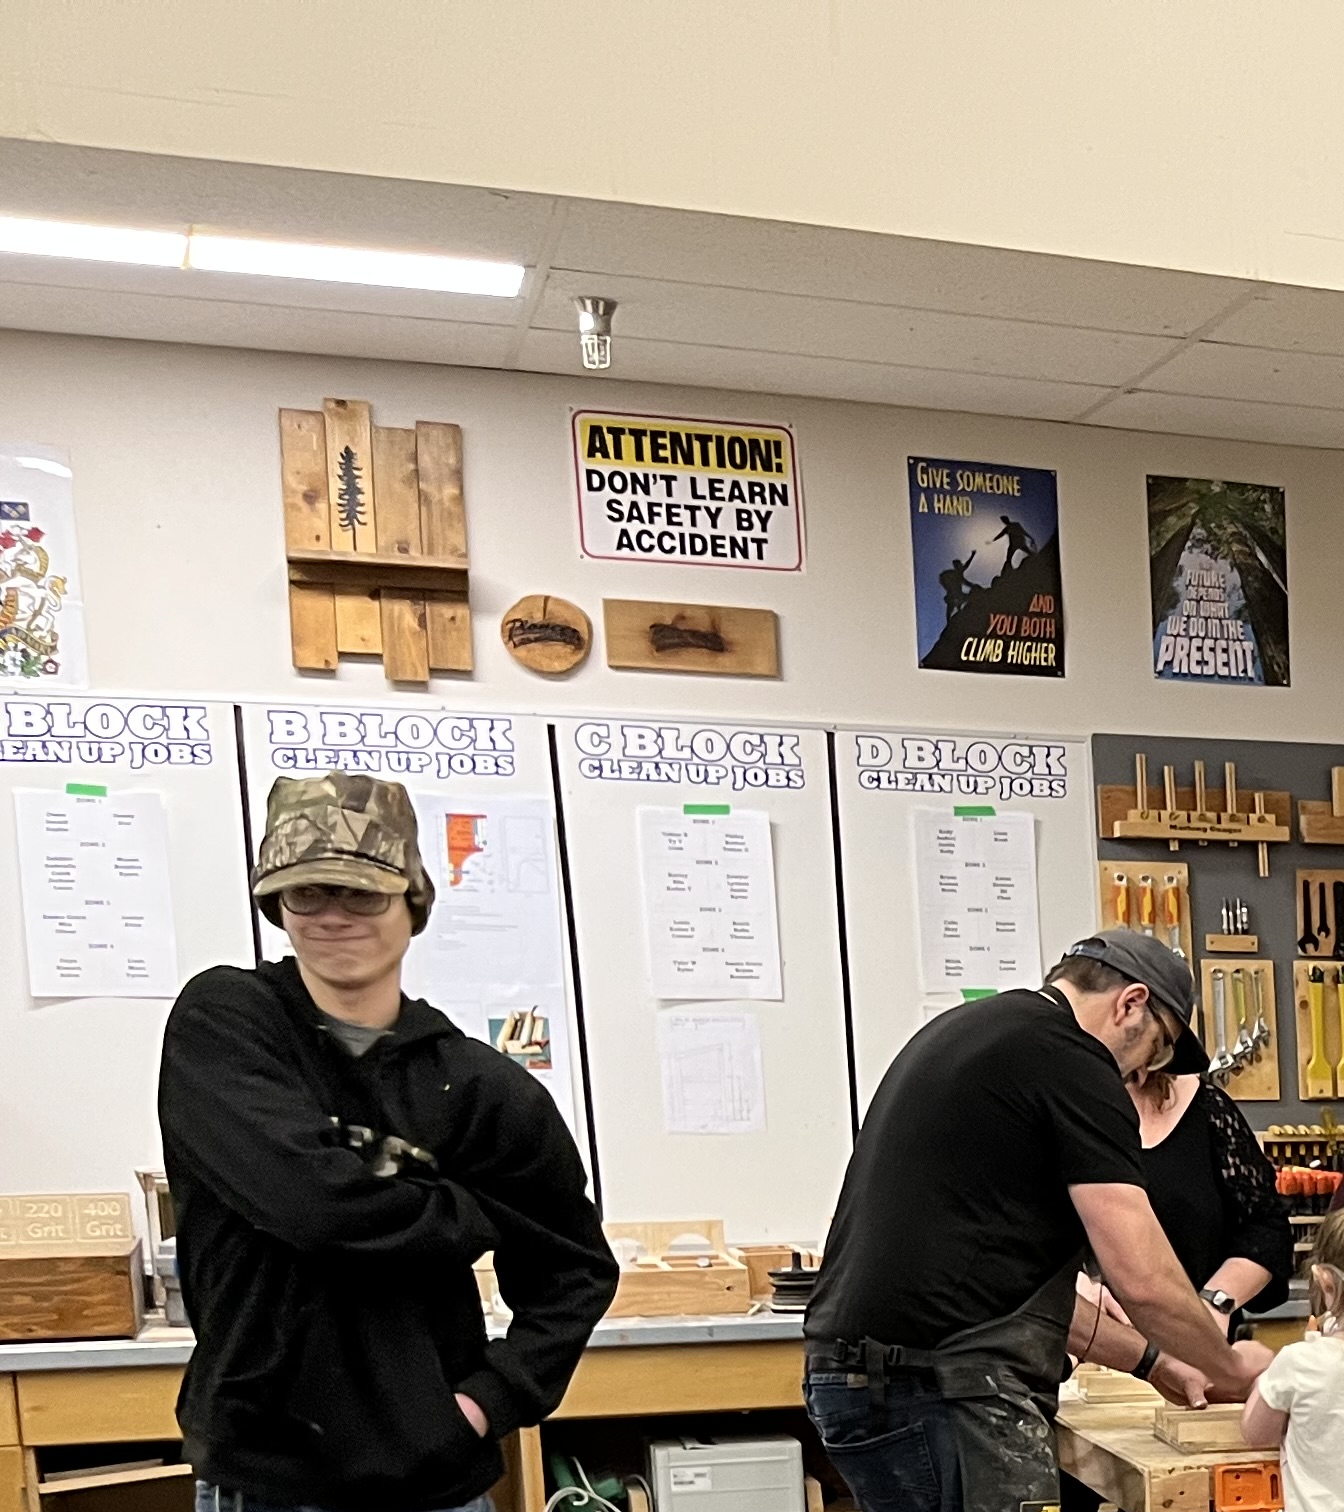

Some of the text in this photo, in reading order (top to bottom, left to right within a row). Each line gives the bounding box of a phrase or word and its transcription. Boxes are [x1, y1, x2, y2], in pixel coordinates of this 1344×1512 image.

[587, 424, 784, 474] ATTENTION!
[585, 468, 789, 506] DON'T LEARN
[956, 470, 1021, 497] SOMEONE
[606, 498, 773, 533] SAFETY BY
[918, 493, 973, 517] A HAND
[616, 528, 769, 561] ACCIDENT
[1185, 569, 1226, 587] FUTURE
[1028, 593, 1055, 614] AND
[986, 613, 1056, 639] YOU BOTH
[1166, 615, 1188, 636] WE
[1189, 617, 1206, 638] DO
[1222, 619, 1245, 640] THE
[960, 636, 1057, 667] CLIMB HIGHER
[1155, 635, 1256, 679] PRESENT
[5, 702, 210, 741] BLOCK
[267, 710, 515, 752] B BLOCK
[0, 740, 213, 769] EAN UP JOBS
[574, 722, 801, 767] C BLOCK
[855, 735, 1067, 777] D BLOCK
[271, 747, 515, 779] CLEAN UP JOBS
[578, 758, 806, 791] CLEAN UP JOBS
[858, 769, 1067, 800] CLEAN UP JOBS
[24, 1202, 63, 1218] 220
[82, 1201, 121, 1217] 400
